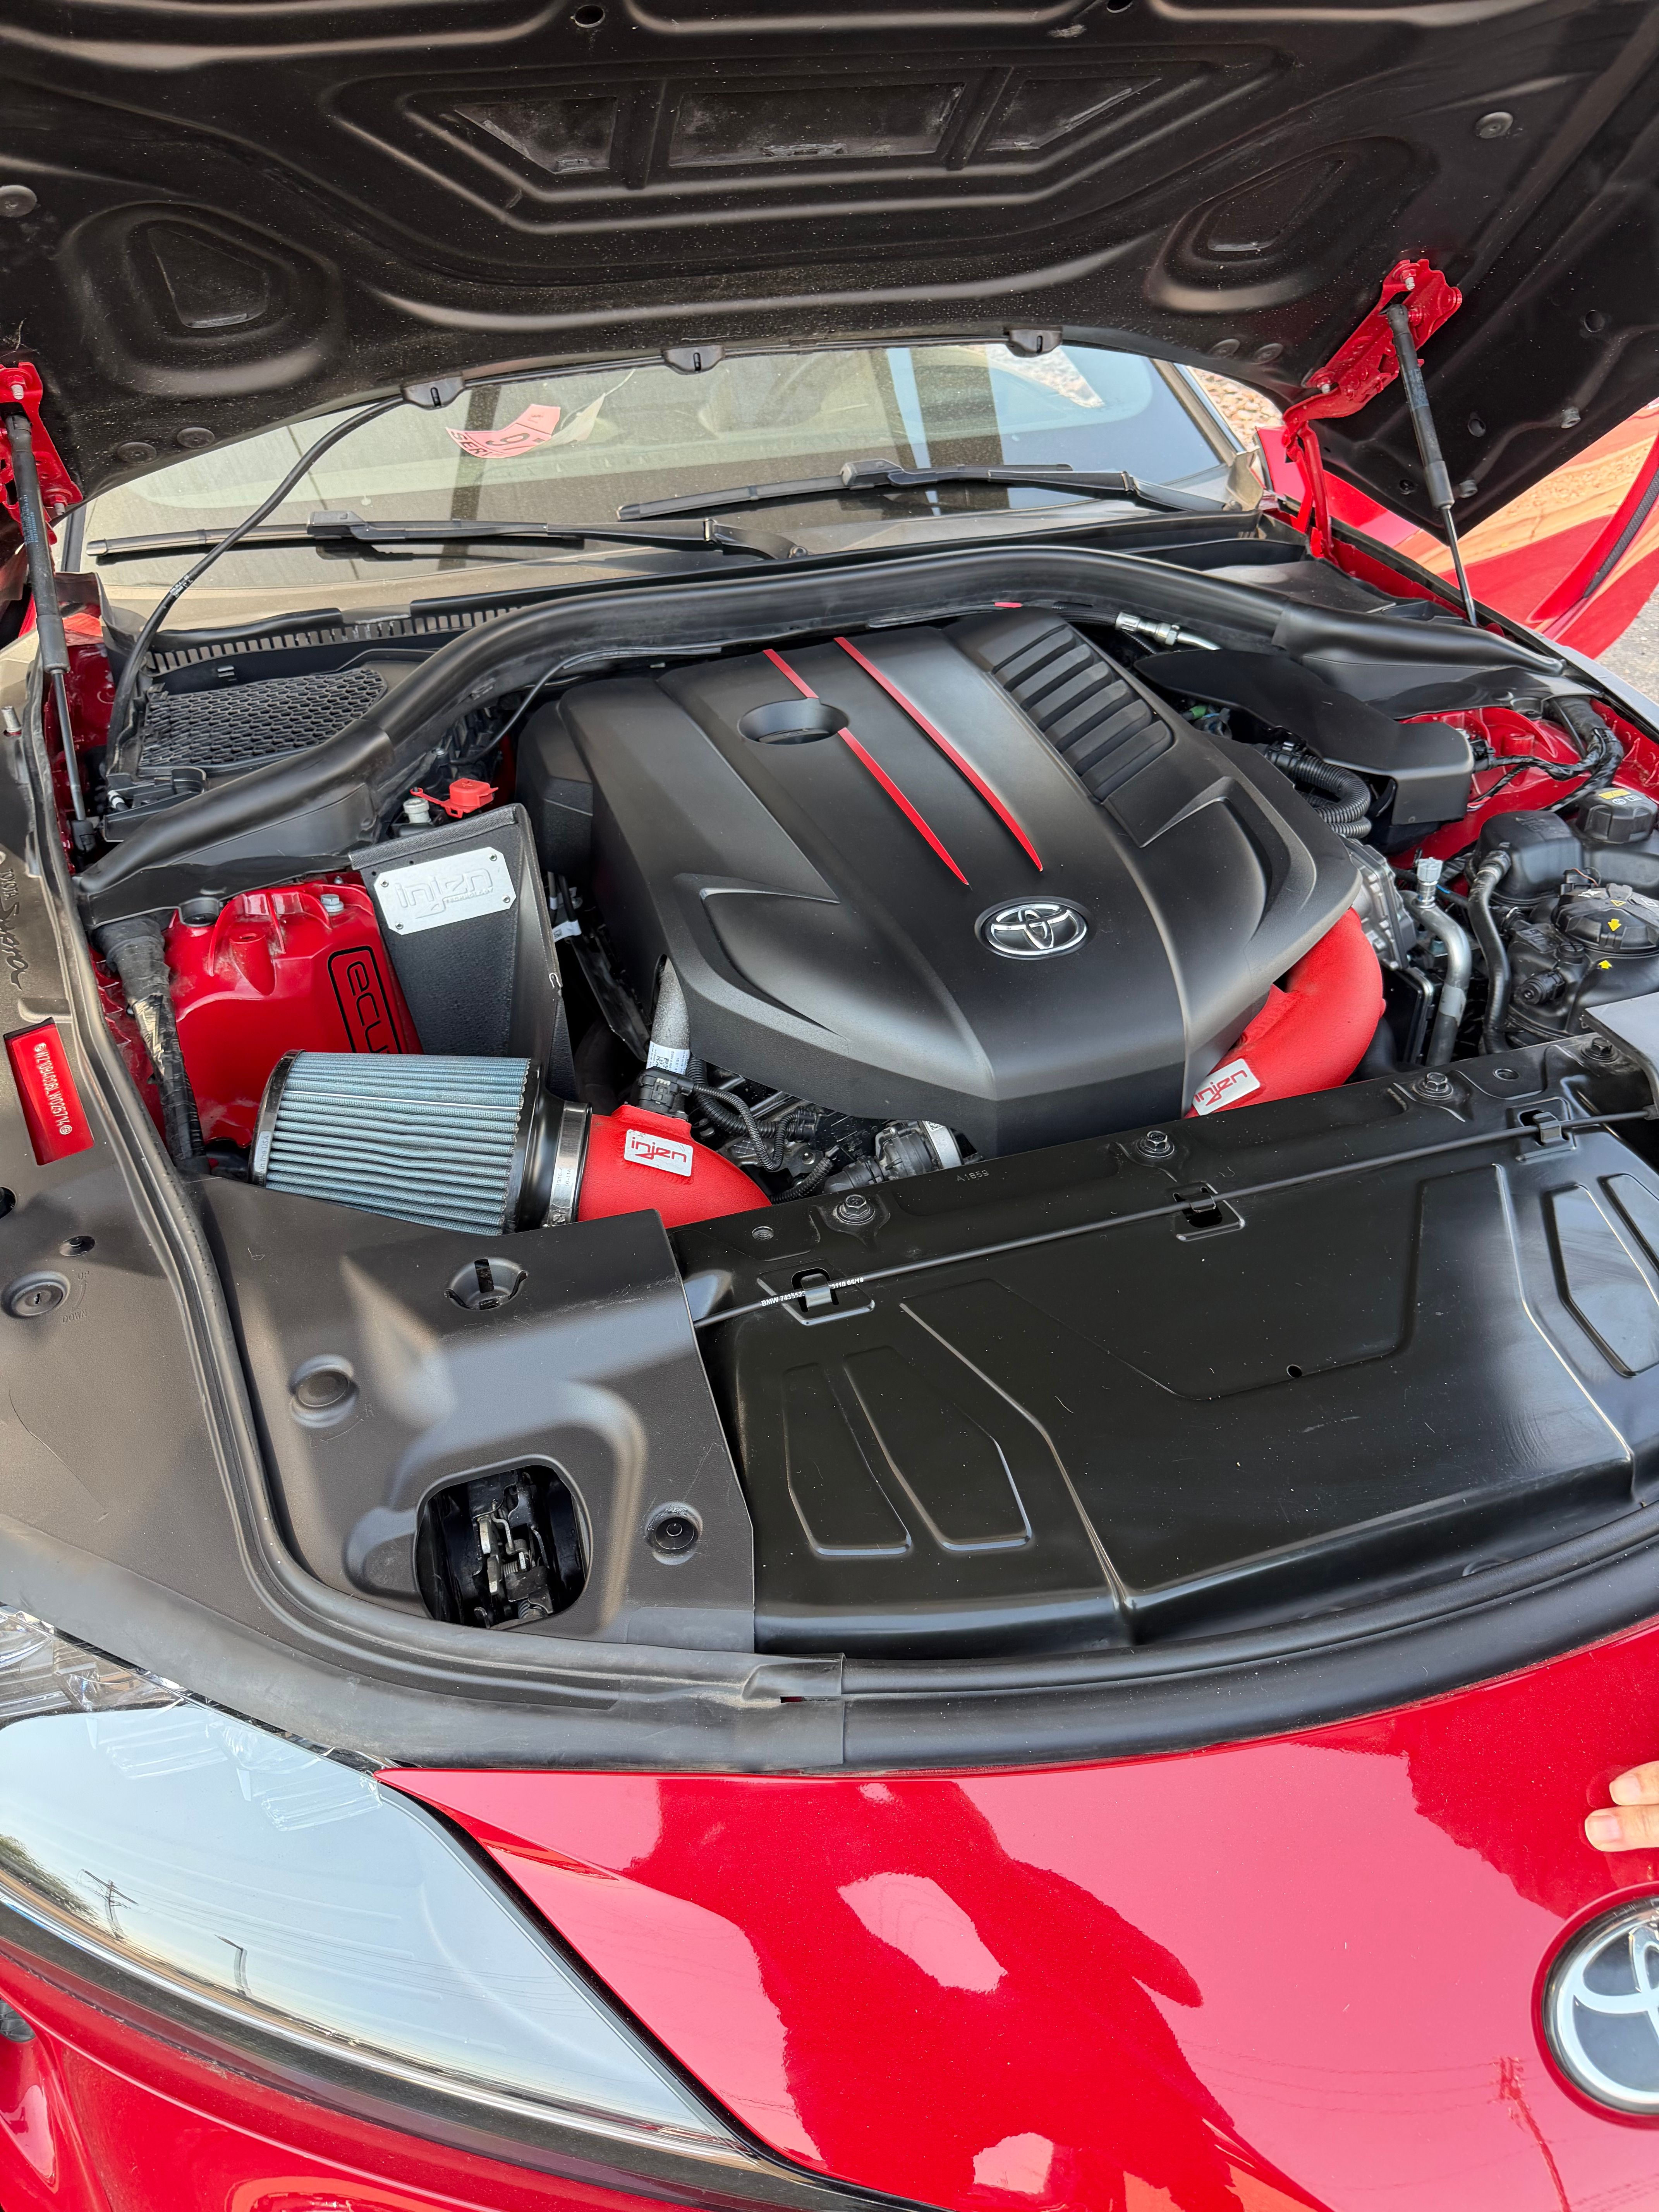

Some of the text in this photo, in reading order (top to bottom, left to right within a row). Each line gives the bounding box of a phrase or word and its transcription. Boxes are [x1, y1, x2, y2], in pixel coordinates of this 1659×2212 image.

[0, 869, 19, 901] TOYOTA
[1194, 1070, 1247, 1106] injen
[262, 1135, 270, 1149] USA
[631, 1136, 687, 1163] injen
[957, 1170, 989, 1182] A1859
[761, 1297, 778, 1307] BMW
[62, 1309, 87, 1323] DOWN
[364, 1403, 374, 1418] R
